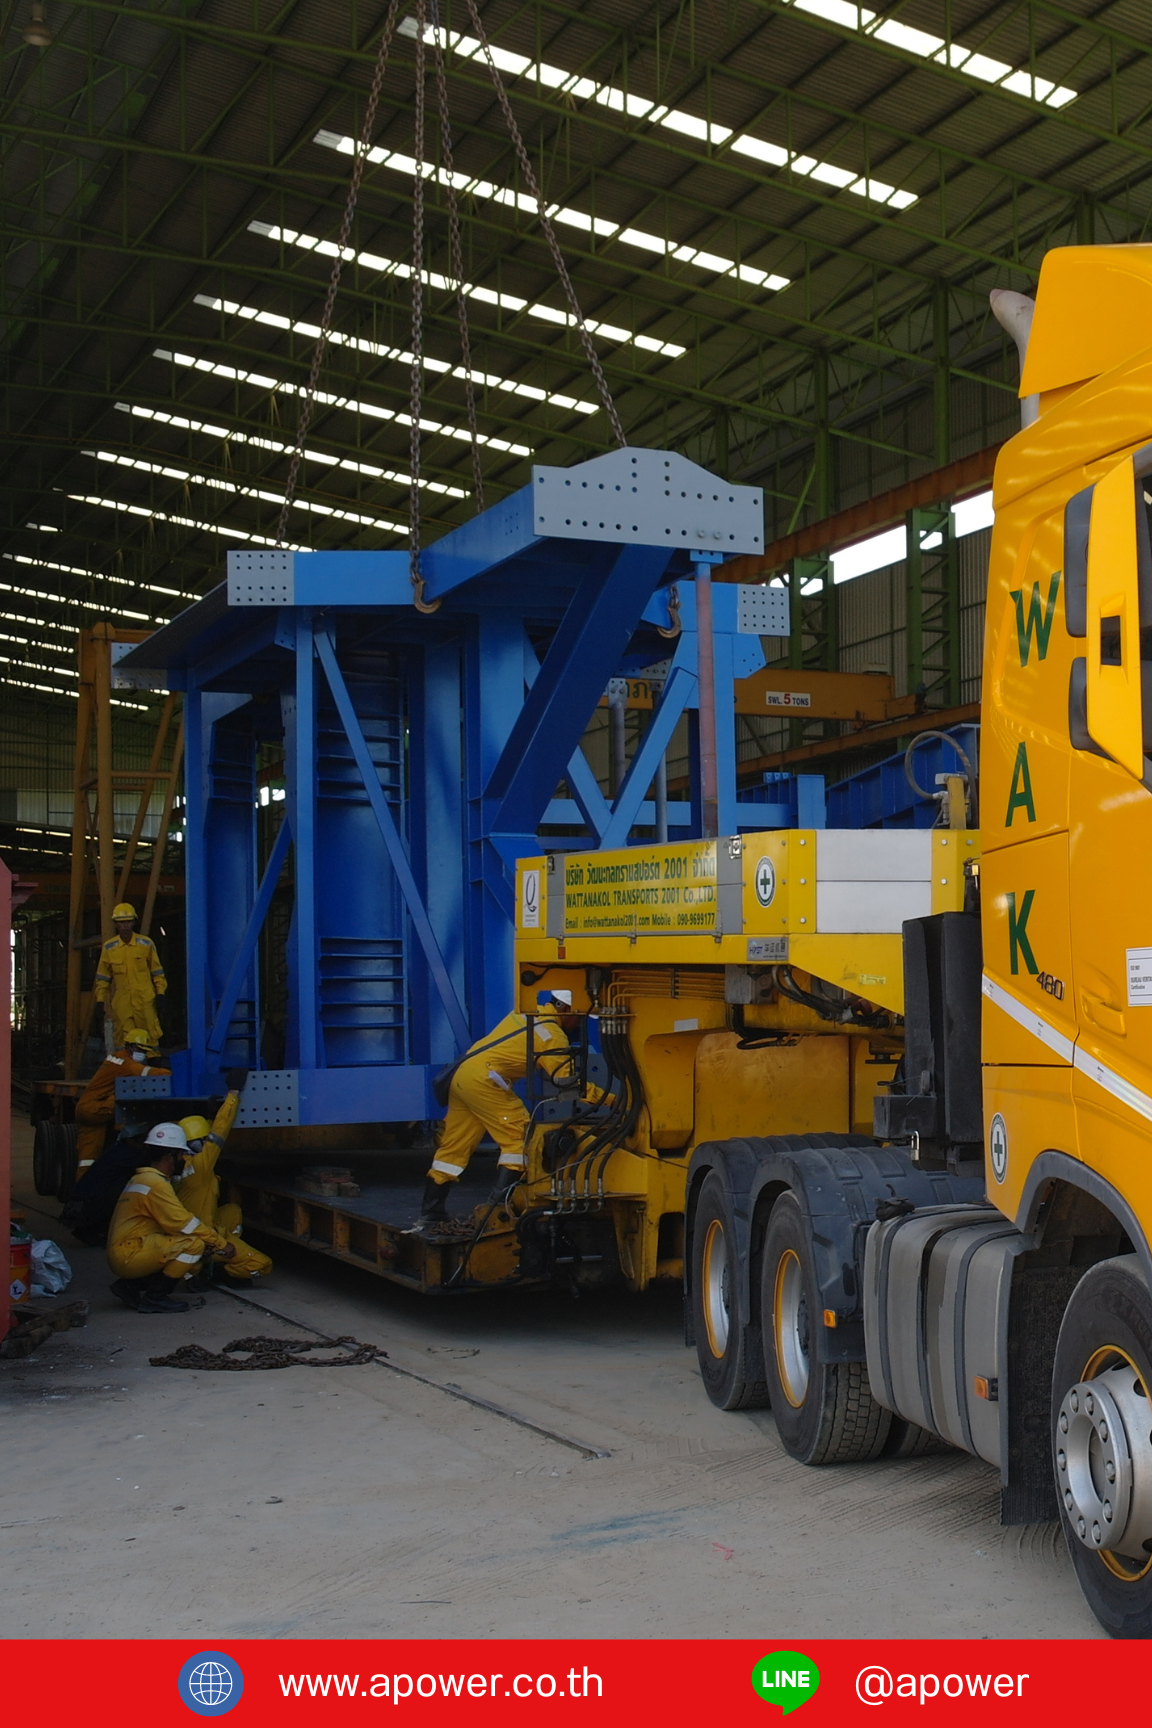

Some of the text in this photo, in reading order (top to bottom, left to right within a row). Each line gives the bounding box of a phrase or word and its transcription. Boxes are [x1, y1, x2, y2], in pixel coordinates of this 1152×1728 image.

[783, 693, 791, 705] 5
[793, 697, 809, 706] TONS
[664, 857, 688, 879] 2001
[566, 891, 611, 908] WATTANAKOL
[613, 887, 659, 906] TRANSPORTS
[662, 887, 680, 904] 2001
[565, 916, 578, 929] Email
[652, 913, 671, 926] Mobile
[1036, 970, 1064, 1000] 480
